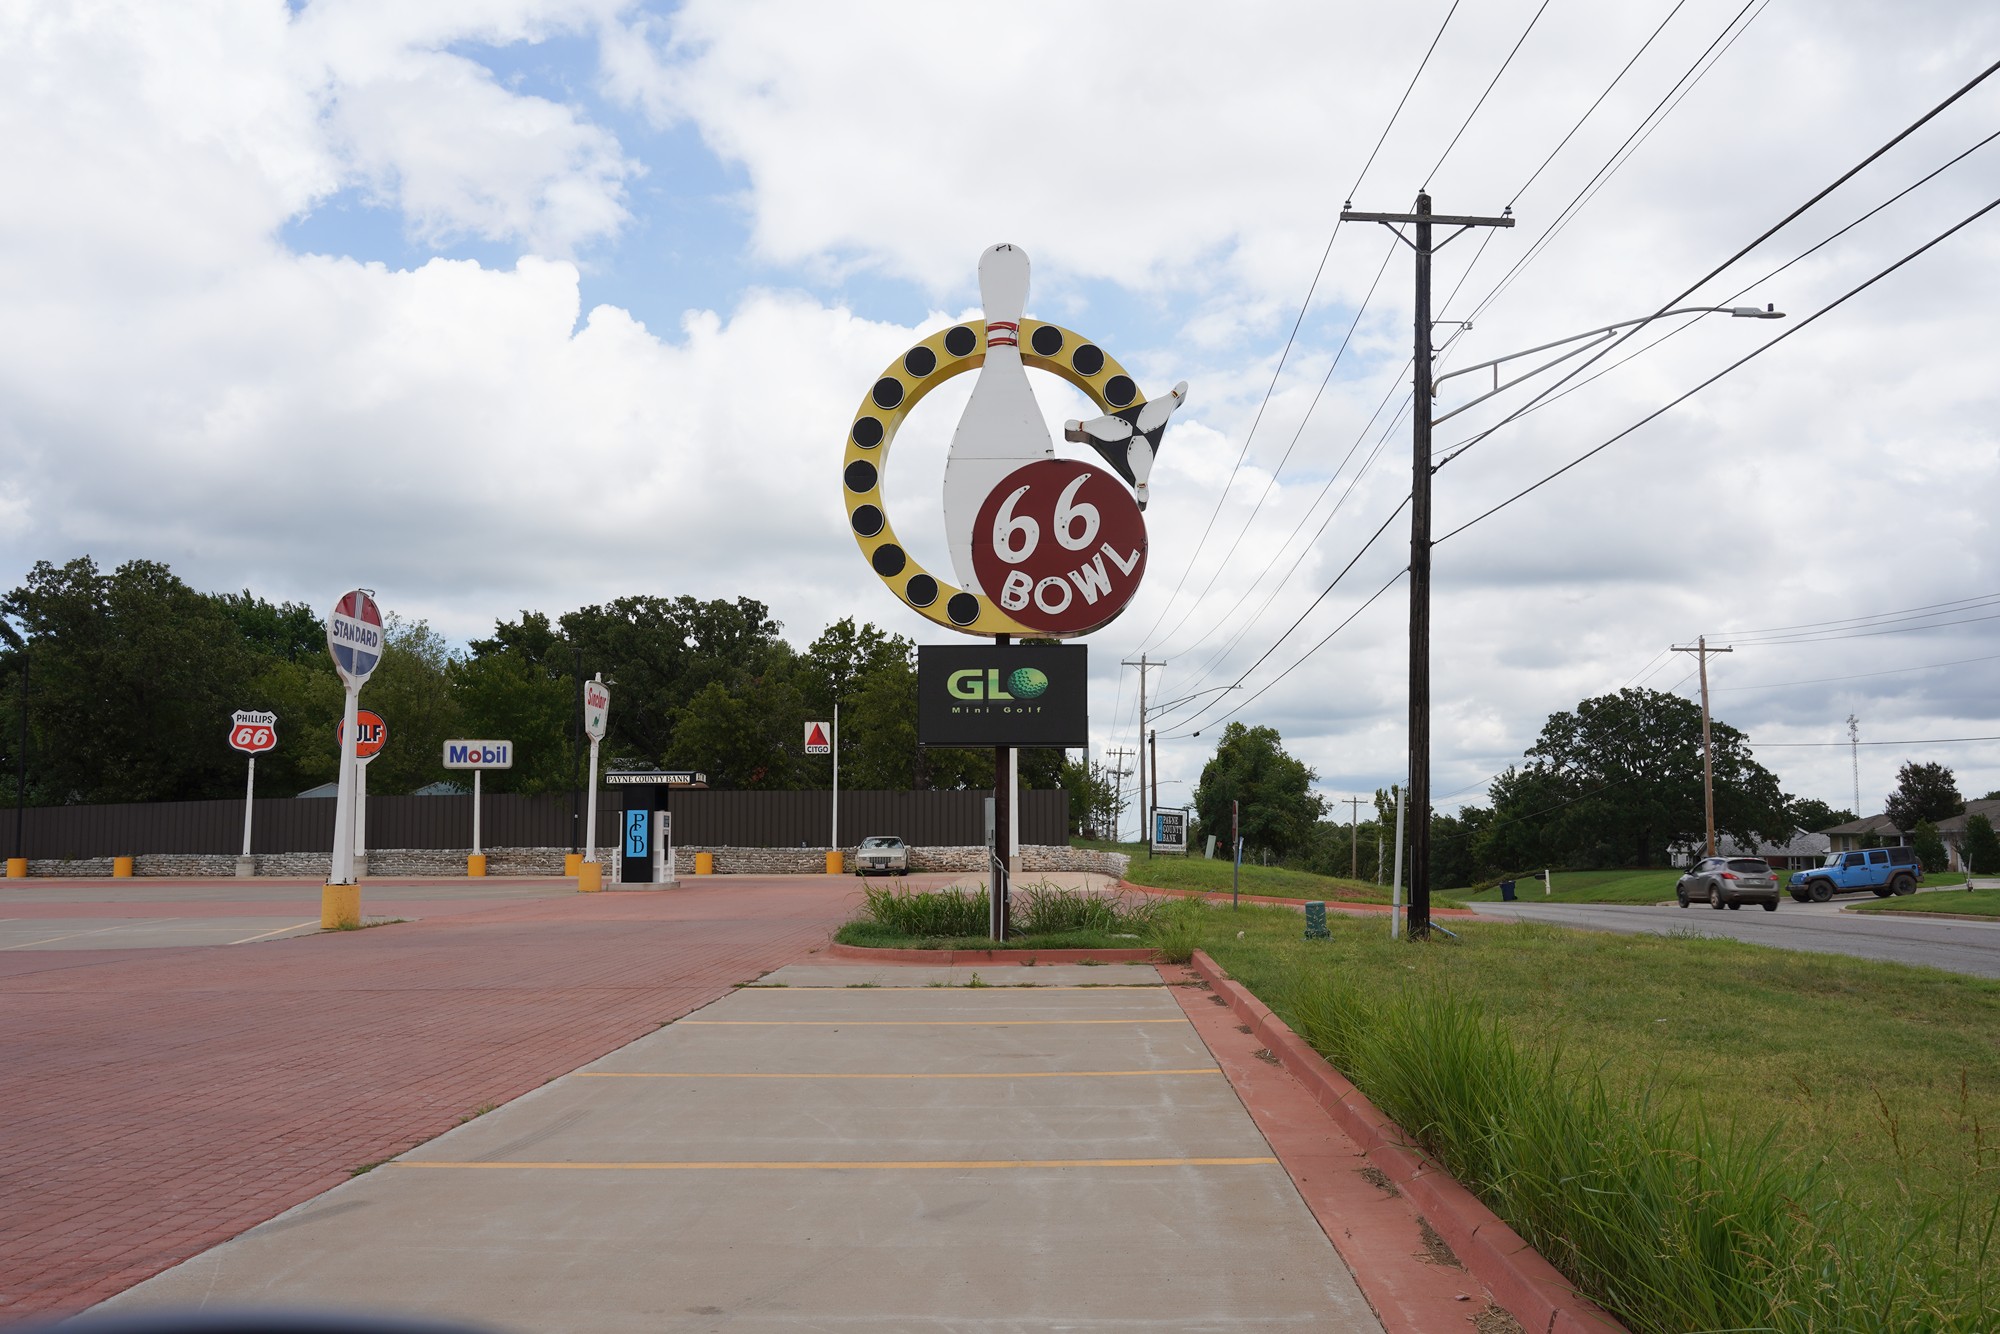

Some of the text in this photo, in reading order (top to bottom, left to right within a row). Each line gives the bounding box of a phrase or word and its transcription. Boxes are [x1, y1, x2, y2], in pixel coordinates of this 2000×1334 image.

[992, 473, 1101, 564] 66
[1000, 542, 1140, 615] BOWL
[333, 619, 378, 648] STANDARD
[236, 714, 273, 724] PHILLIPS
[236, 728, 270, 746] 66
[340, 724, 383, 744] ULF
[449, 745, 507, 763] Mobil
[607, 775, 634, 783] PAYNE
[634, 775, 665, 783] COUNTY
[667, 775, 690, 783] BANK
[1163, 825, 1182, 834] COUNTY
[1163, 834, 1176, 842] BANK
